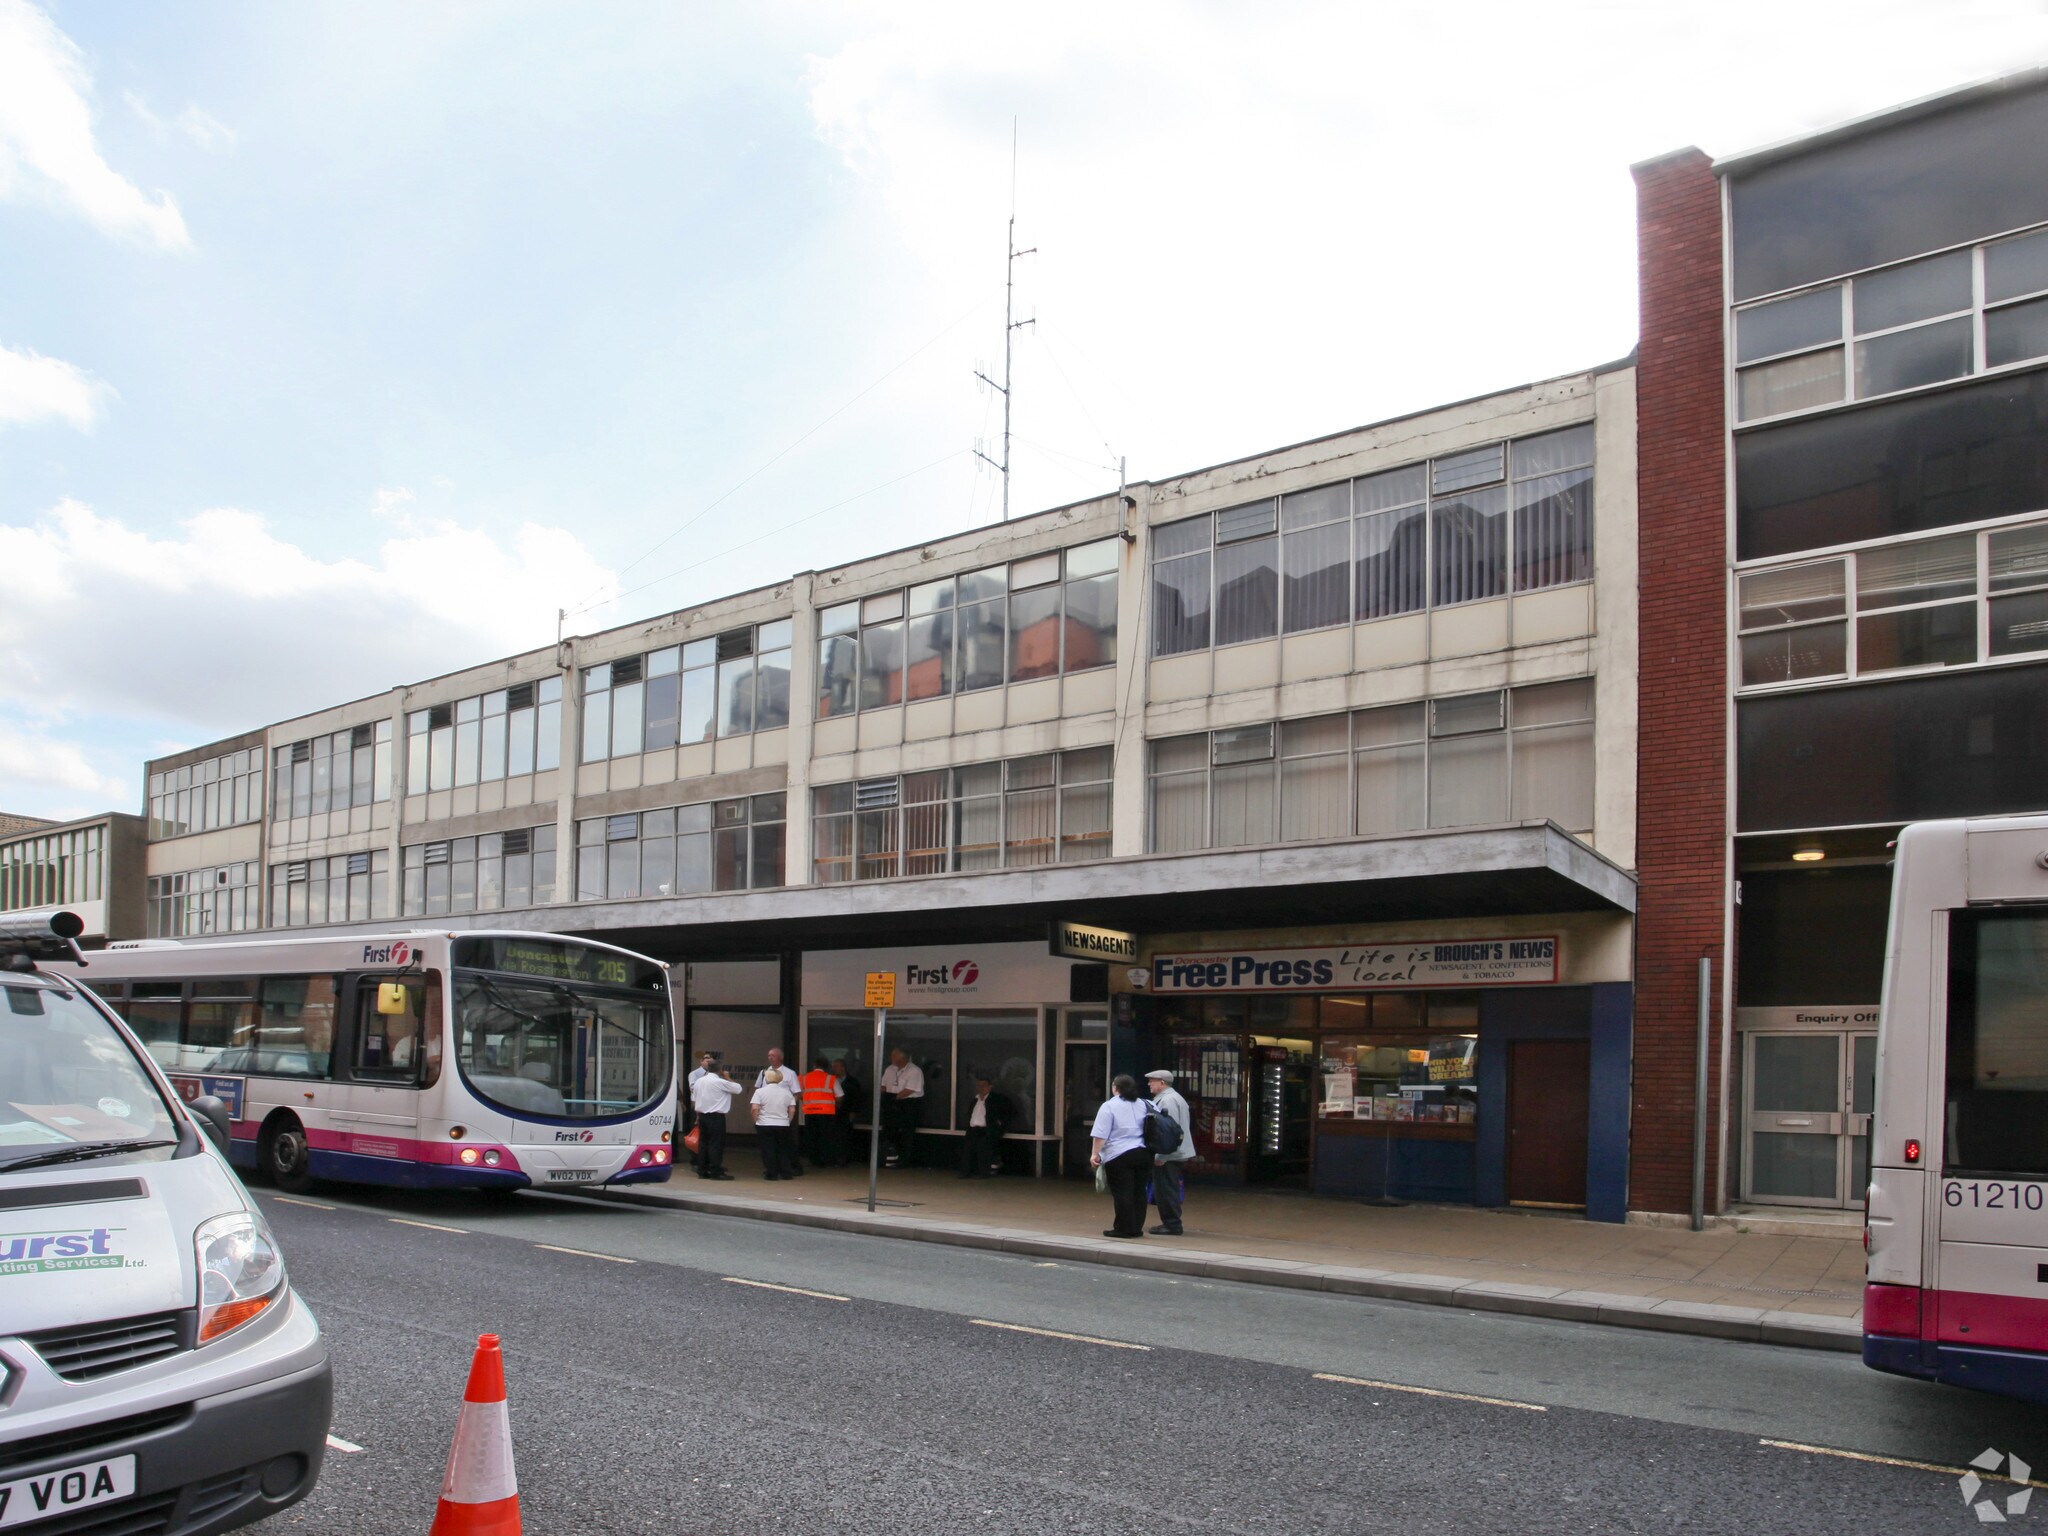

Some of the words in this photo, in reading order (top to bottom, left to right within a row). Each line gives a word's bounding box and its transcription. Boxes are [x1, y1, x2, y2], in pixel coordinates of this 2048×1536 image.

[1064, 930, 1135, 956] NEWSAGENTS
[363, 945, 390, 963] First
[506, 946, 581, 966] Doncaster
[1340, 950, 1396, 966] Life
[1408, 948, 1431, 962] is
[1434, 943, 1502, 962] BROUGH'S
[1509, 941, 1553, 960] NEWS
[1174, 956, 1231, 965] Doncaster
[1488, 960, 1552, 970] CONFECTIONS
[598, 959, 626, 982] 205
[906, 965, 948, 984] First
[1154, 959, 1227, 988] Free
[1231, 956, 1334, 986] Press
[1352, 965, 1416, 982] local
[1474, 970, 1515, 979] TOBACCO
[1796, 1014, 1849, 1024] Enquiry
[1208, 1064, 1234, 1077] Play
[1428, 1064, 1474, 1074] WILDEST
[1206, 1074, 1236, 1085] here
[1429, 1072, 1474, 1081] DREAMS
[650, 1116, 672, 1126] 60744
[555, 1132, 579, 1141] First
[550, 1171, 573, 1180] MV02
[576, 1171, 592, 1180] VDX
[1945, 1182, 2043, 1210] 61210
[44, 1258, 118, 1269] Services
[125, 1260, 148, 1268] Ltd.
[30, 1465, 115, 1511] VOA
